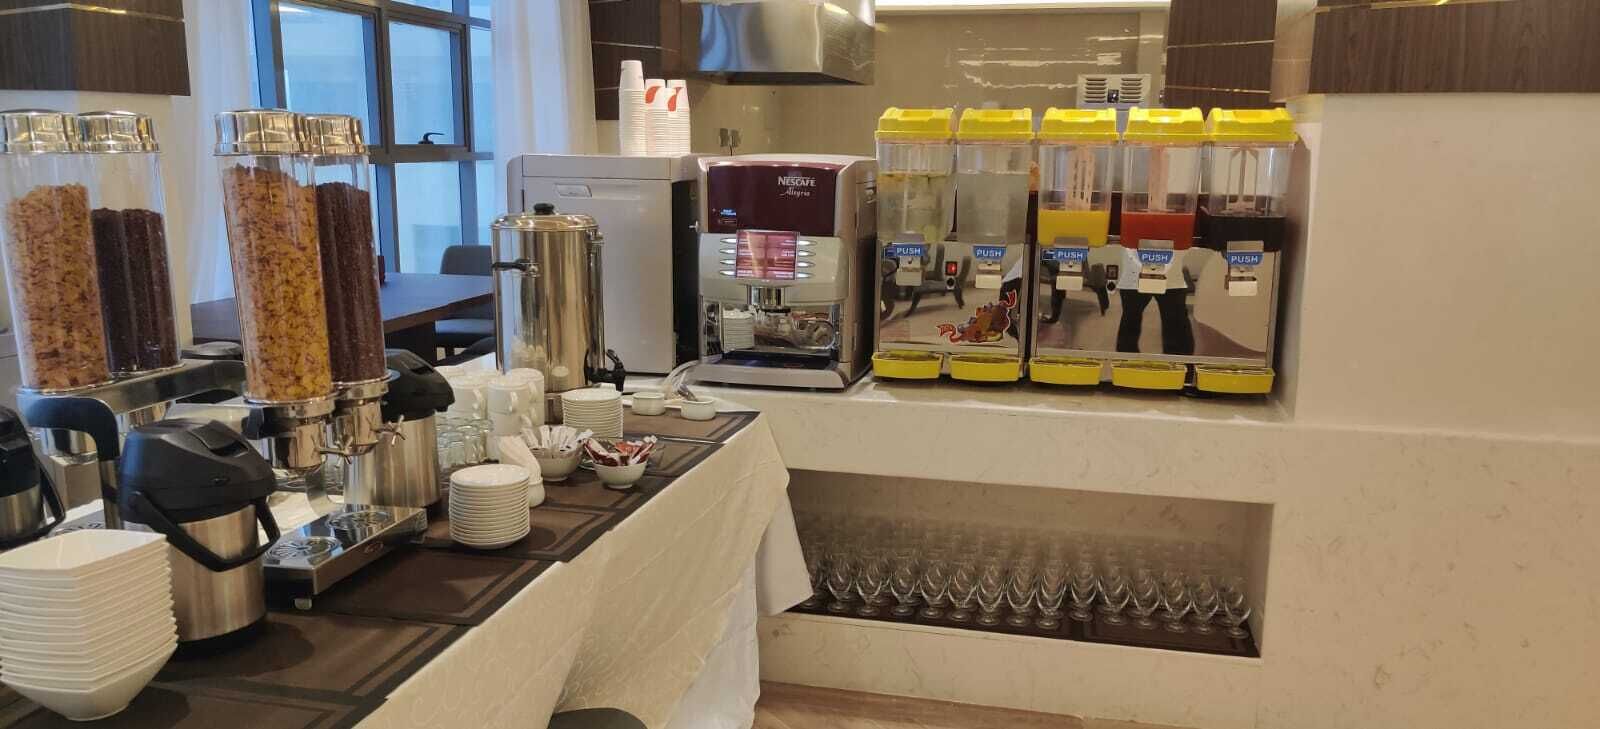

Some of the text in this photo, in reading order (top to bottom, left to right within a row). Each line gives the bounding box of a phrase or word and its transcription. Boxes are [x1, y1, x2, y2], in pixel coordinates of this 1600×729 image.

[896, 247, 921, 255] PUSH
[976, 249, 1002, 257] PUSH
[1057, 251, 1083, 259] PUSH
[1141, 253, 1169, 262] PUSH
[1230, 255, 1258, 263] PUSH
